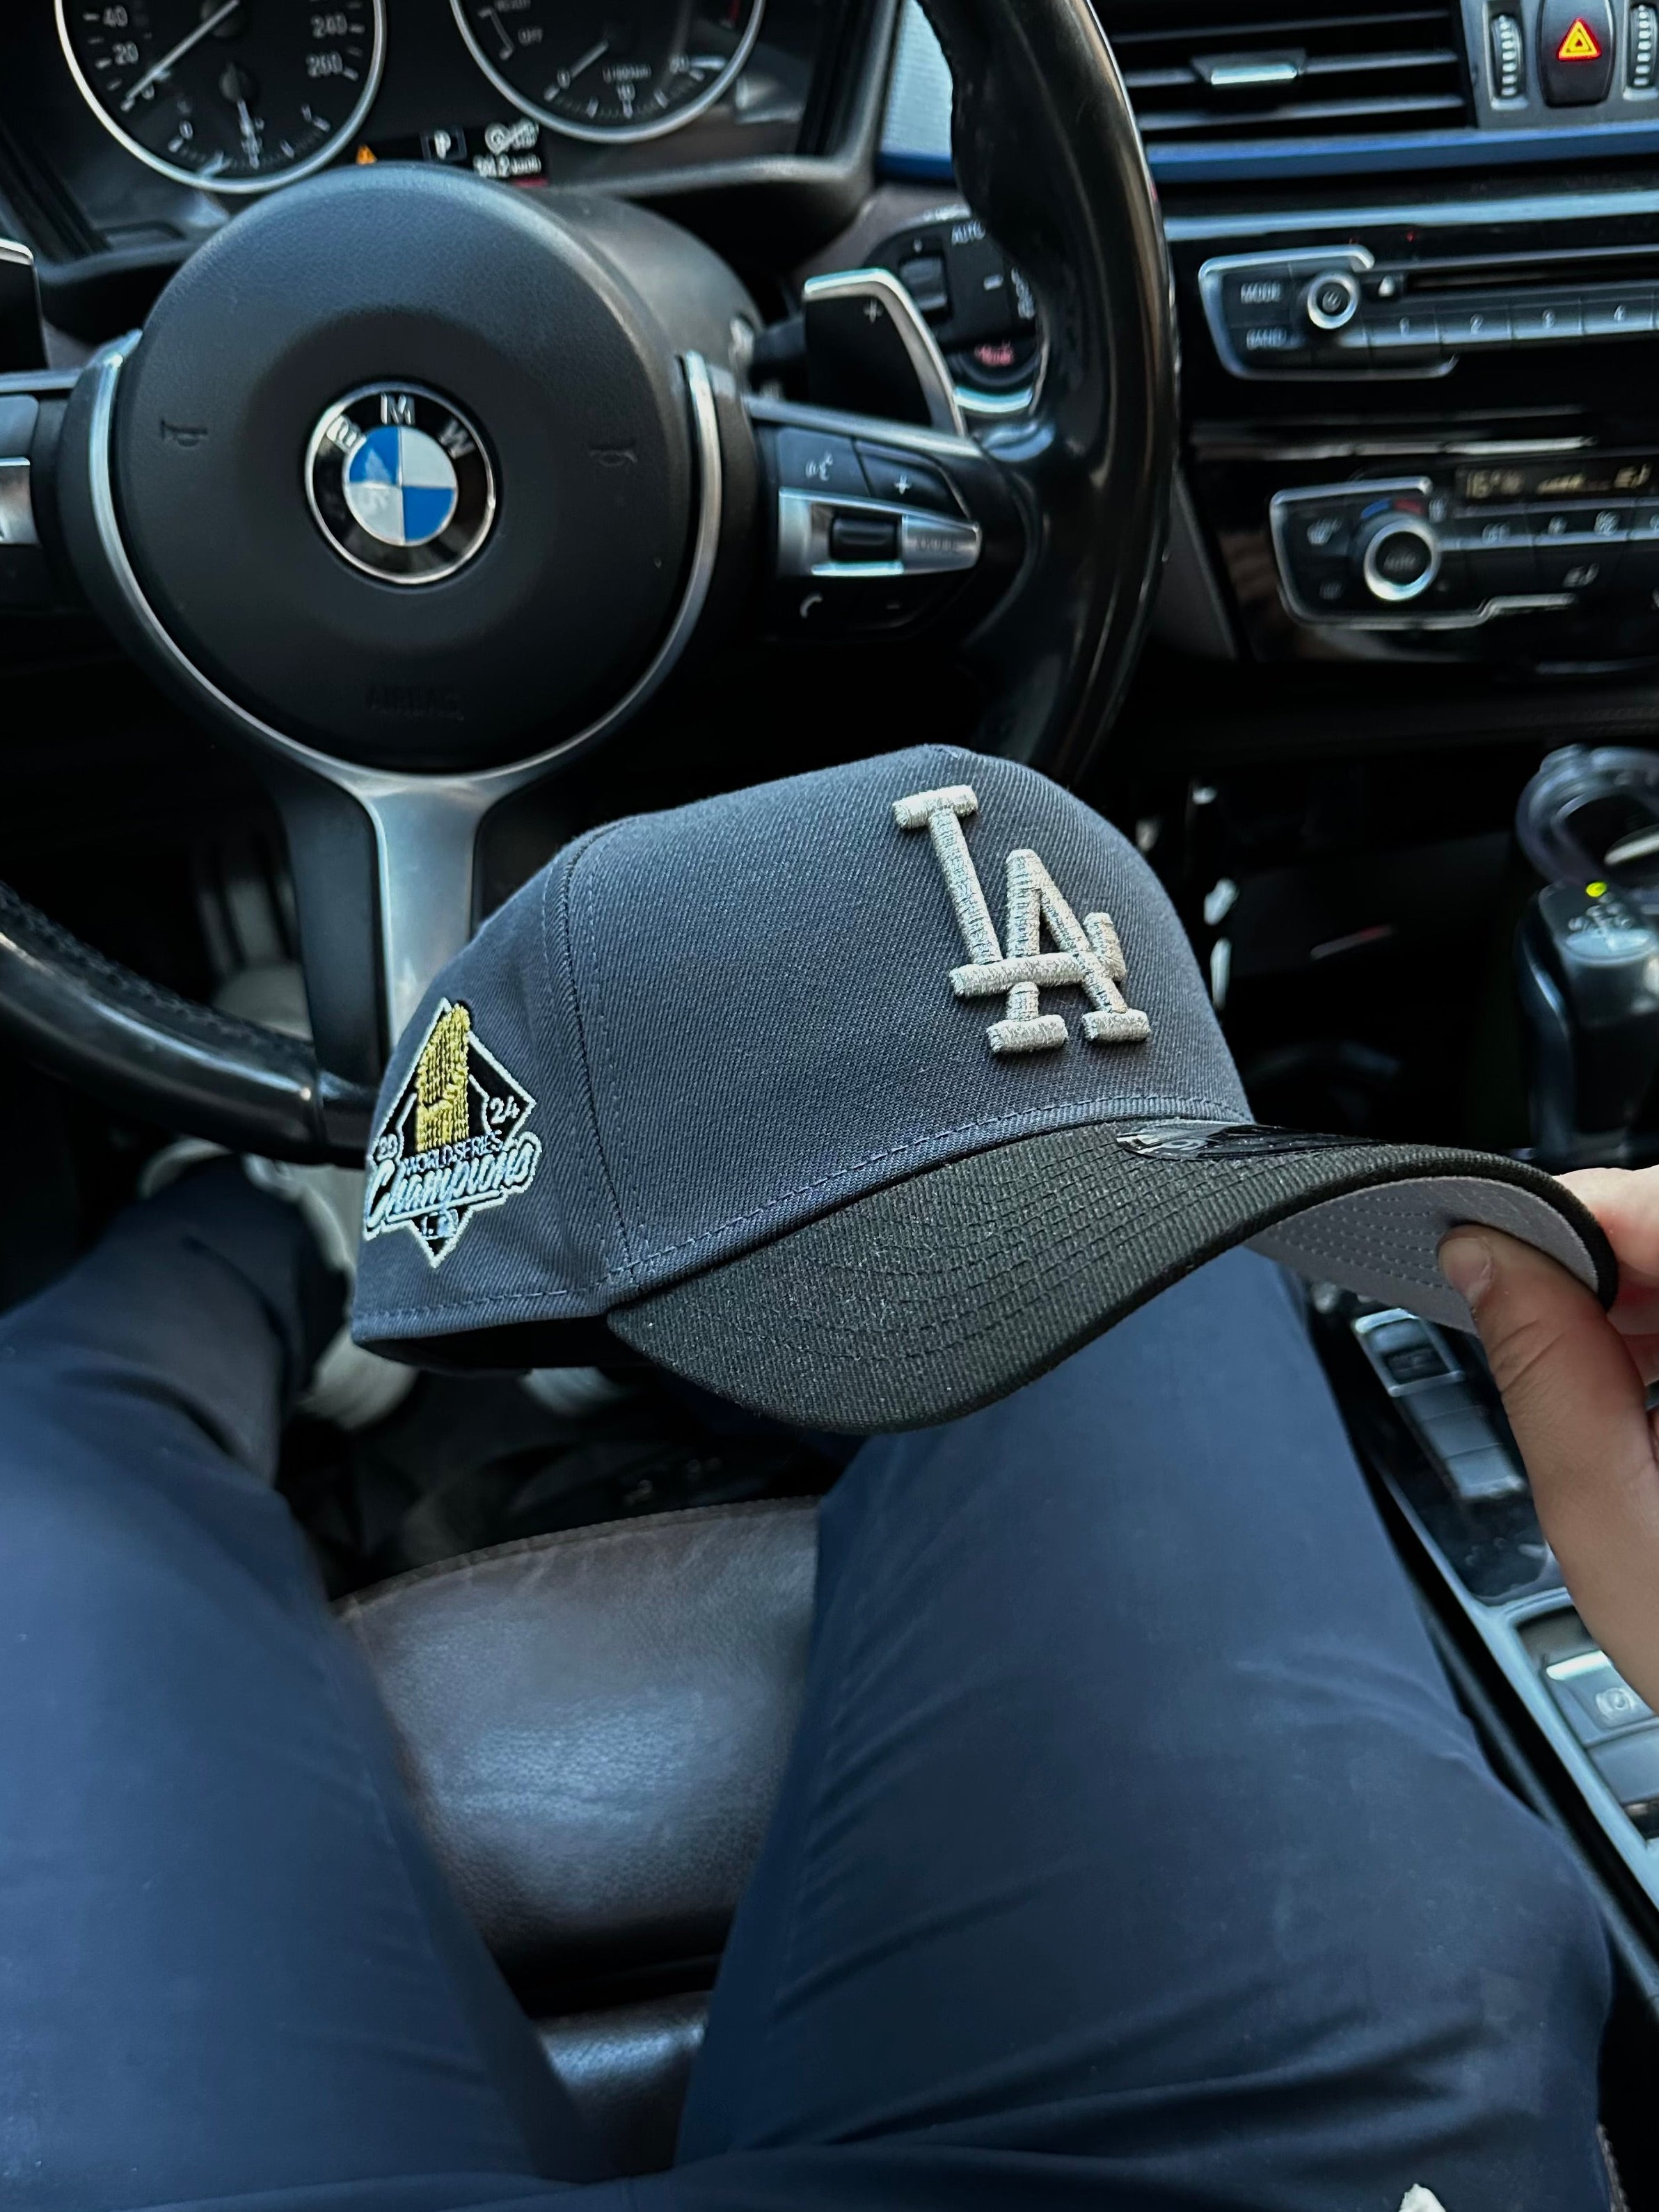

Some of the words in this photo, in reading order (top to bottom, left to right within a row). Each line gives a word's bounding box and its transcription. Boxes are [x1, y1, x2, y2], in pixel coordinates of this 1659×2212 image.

[104, 5, 128, 27] 40
[311, 13, 348, 38] 240
[112, 42, 139, 65] 20
[434, 129, 452, 159] P
[951, 220, 985, 245] AUTO
[1470, 313, 1484, 335] 2
[326, 392, 477, 459] BMW
[893, 784, 1152, 1056] LA
[489, 1095, 521, 1125] 24
[404, 1143, 458, 1177] WORLD
[452, 1129, 503, 1161] SERIES
